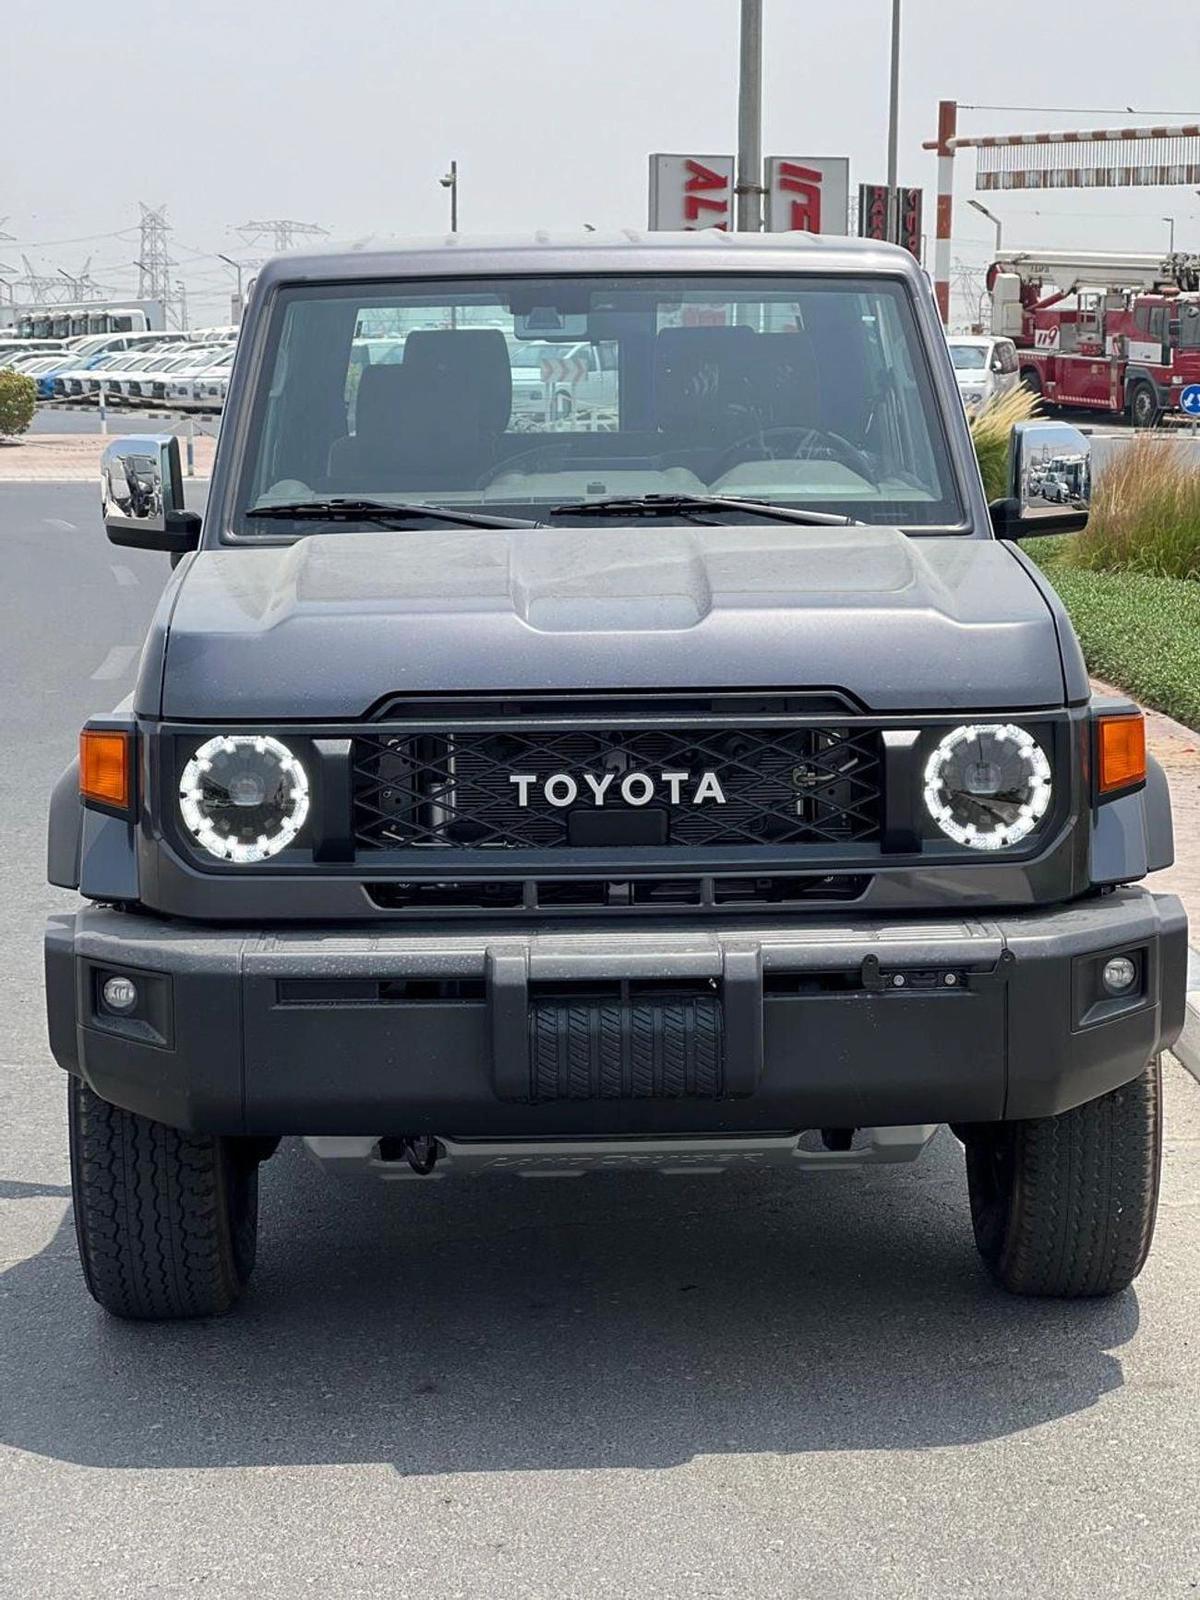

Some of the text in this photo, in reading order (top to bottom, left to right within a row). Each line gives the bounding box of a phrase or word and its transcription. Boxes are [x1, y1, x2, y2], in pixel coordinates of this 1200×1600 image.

[684, 158, 728, 231] AL
[1037, 326, 1058, 345] 119
[509, 772, 727, 807] TOYOTA
